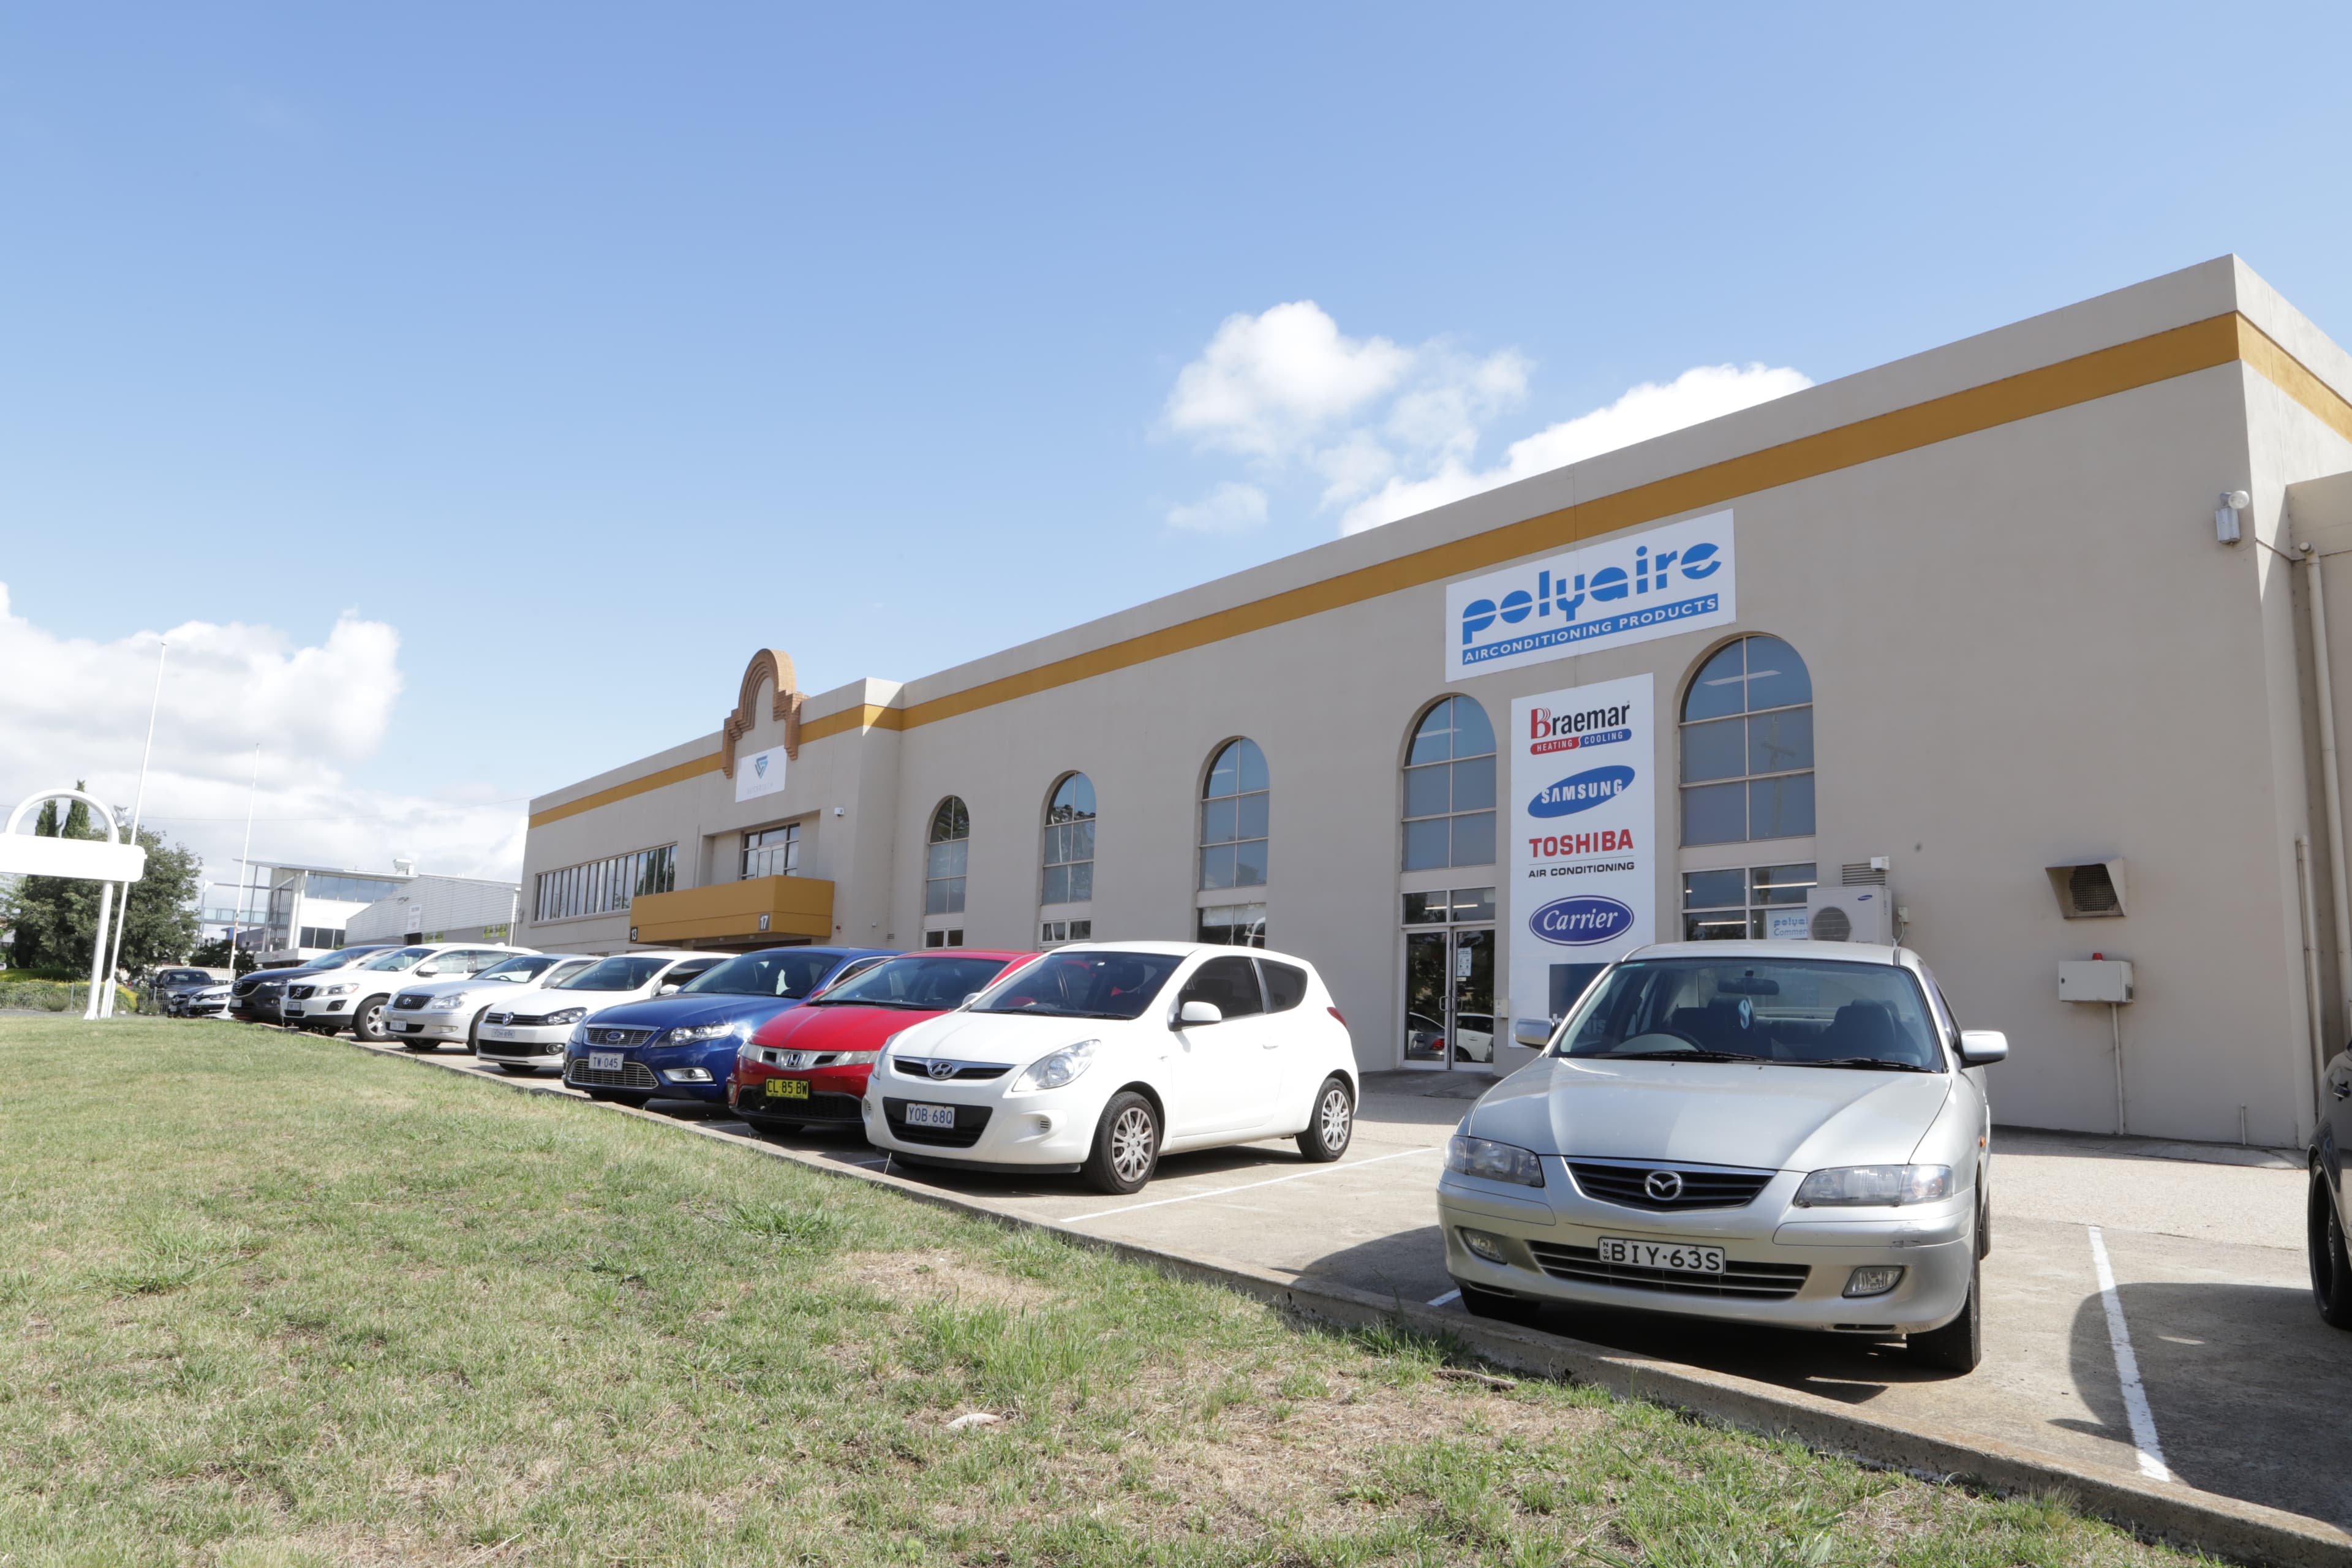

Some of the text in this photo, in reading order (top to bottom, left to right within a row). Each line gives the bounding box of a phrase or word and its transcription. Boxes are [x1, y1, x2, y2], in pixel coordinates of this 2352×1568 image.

[1463, 543, 1722, 645] polyaire
[1464, 597, 1717, 663] AIRCONDITIONING PRODUCTS
[1531, 704, 1630, 739] Braemar
[1537, 731, 1623, 752] HEATING COOLING
[1540, 779, 1623, 804] SAMSUNG
[1529, 829, 1634, 858] TOSHIBA
[1528, 862, 1635, 878] AIR CONDITIONING
[760, 915, 769, 930] 17
[1543, 908, 1618, 931] Carrier
[631, 928, 638, 941] 13
[1774, 928, 1808, 937] Commer
[1602, 1241, 1610, 1261] NSW
